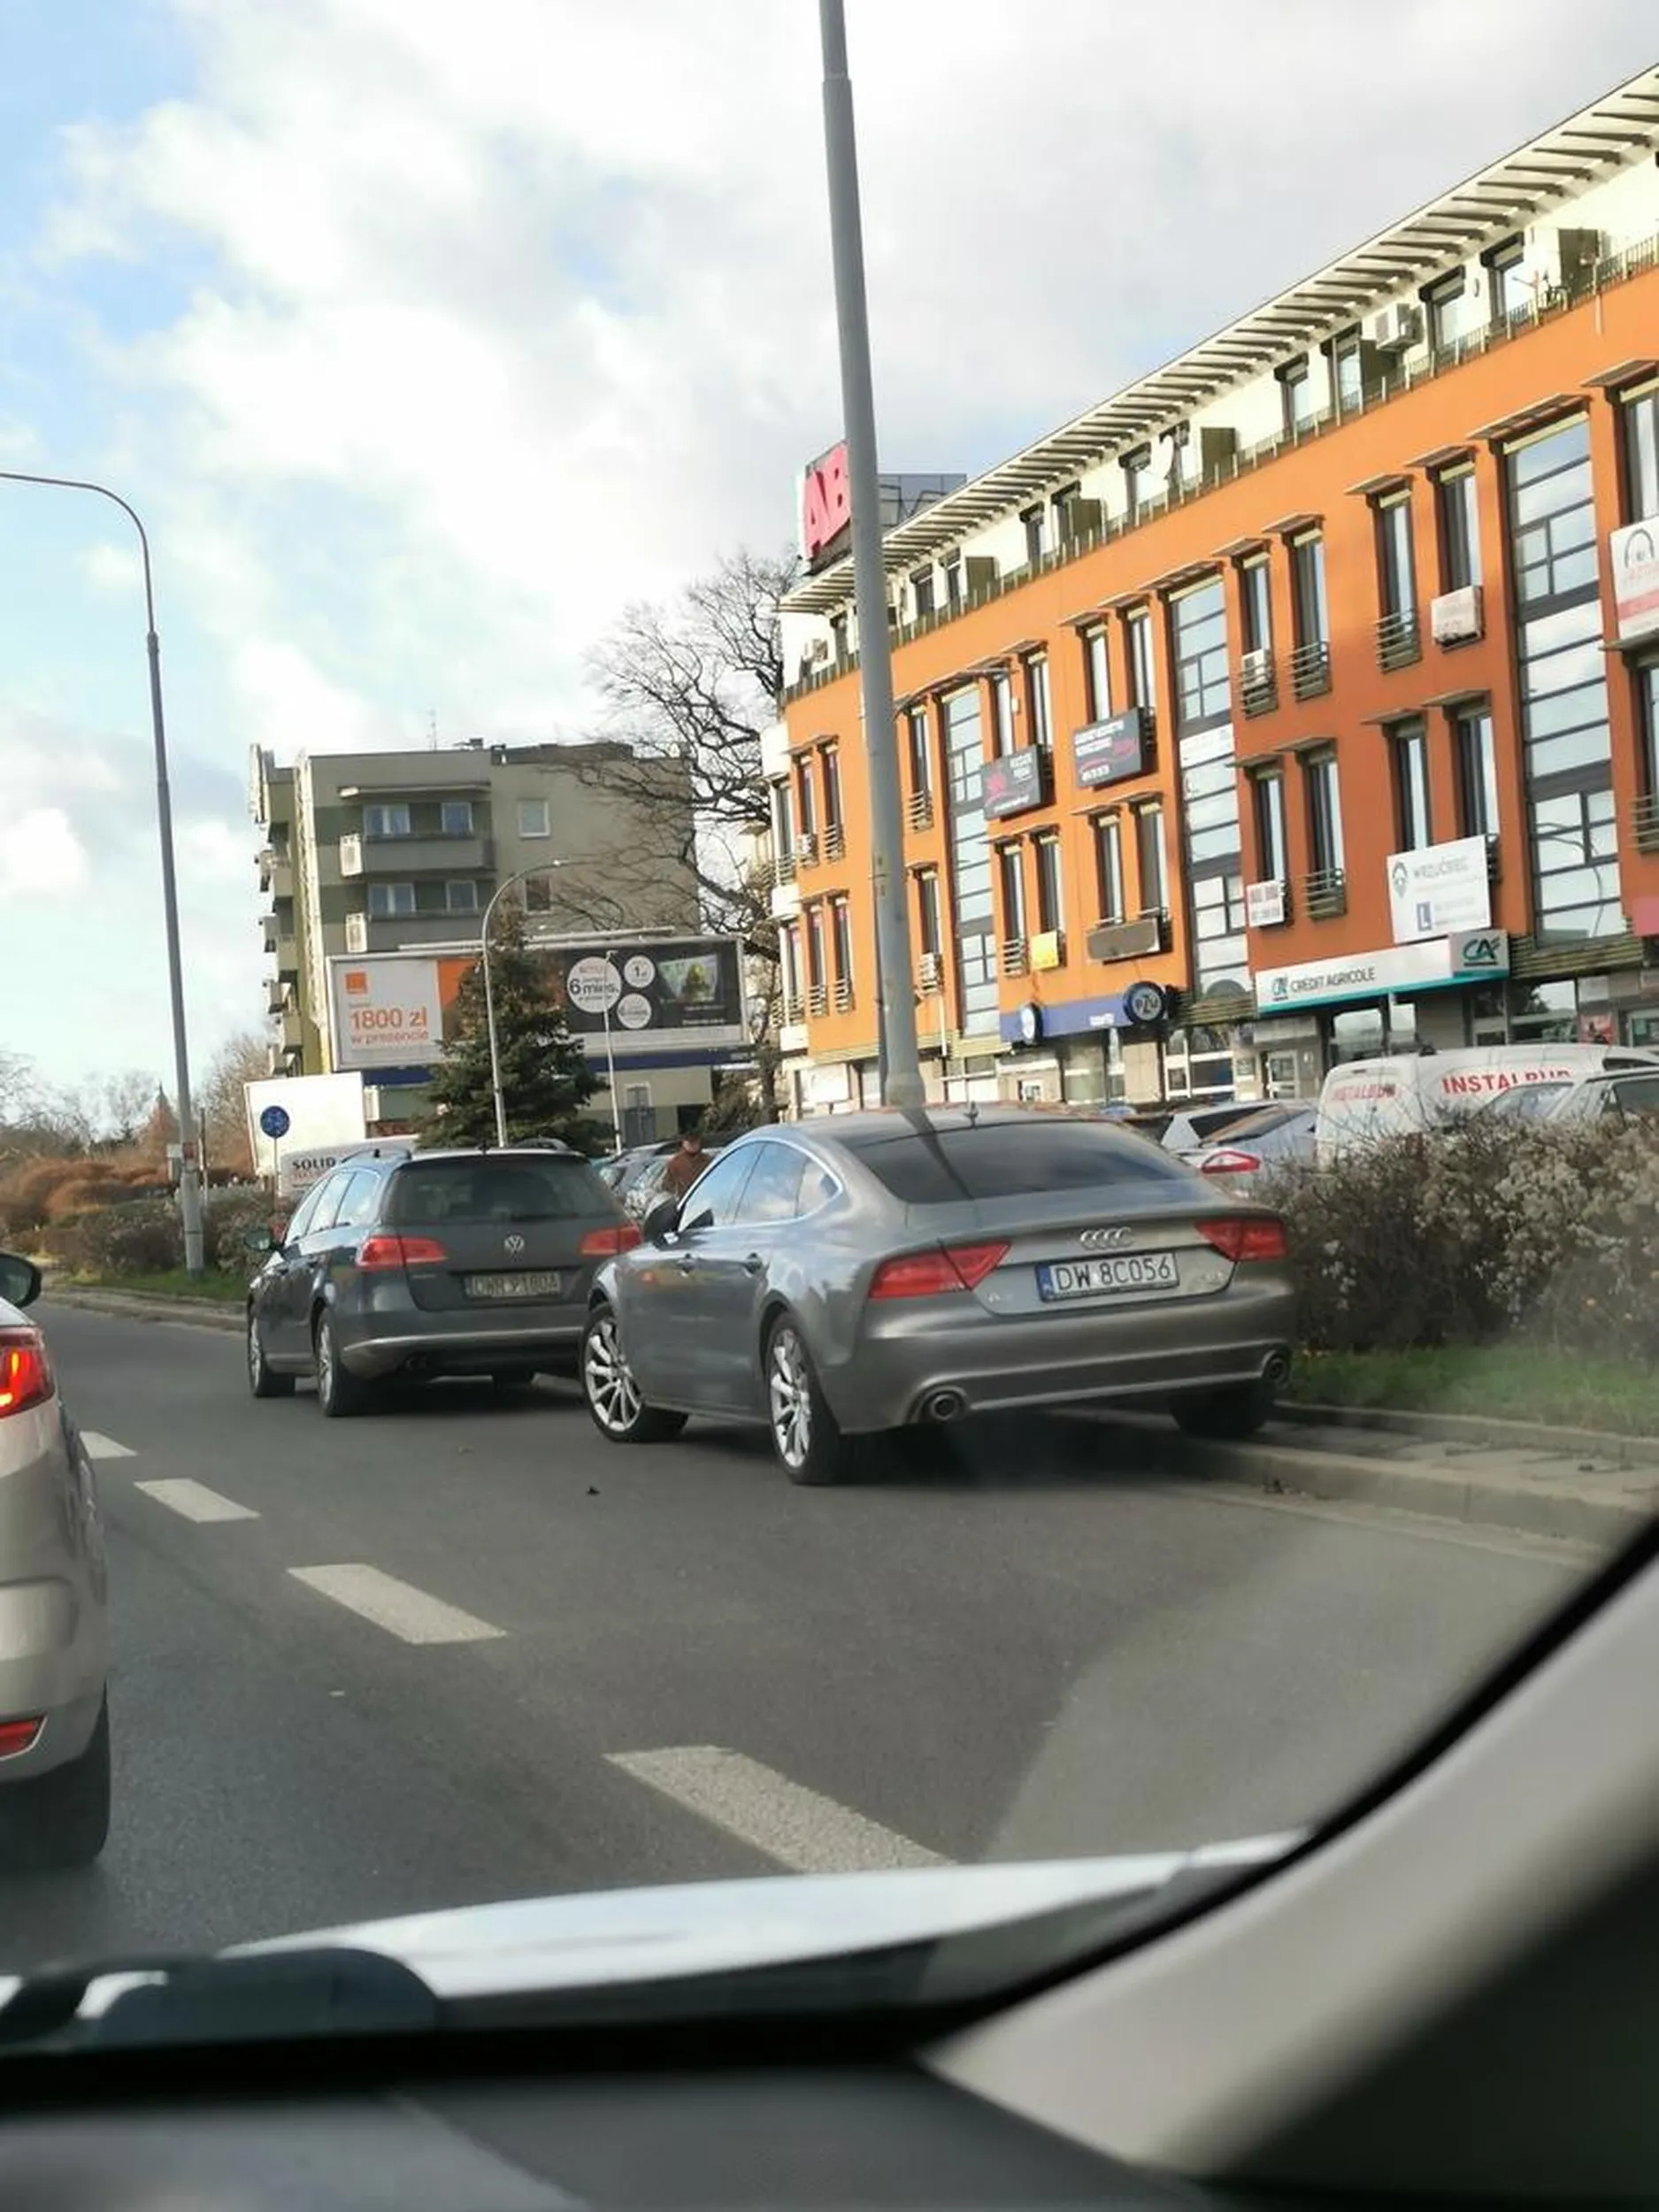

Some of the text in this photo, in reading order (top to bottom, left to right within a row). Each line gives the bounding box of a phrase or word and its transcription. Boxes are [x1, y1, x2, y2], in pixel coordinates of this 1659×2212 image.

[1463, 938, 1499, 961] CA
[570, 978, 581, 995] 6
[1327, 967, 1375, 986] AGRICOLE
[349, 1006, 427, 1030] 1800 zł
[292, 1156, 336, 1170] SOLID
[1056, 1256, 1172, 1291] DW 8C056
